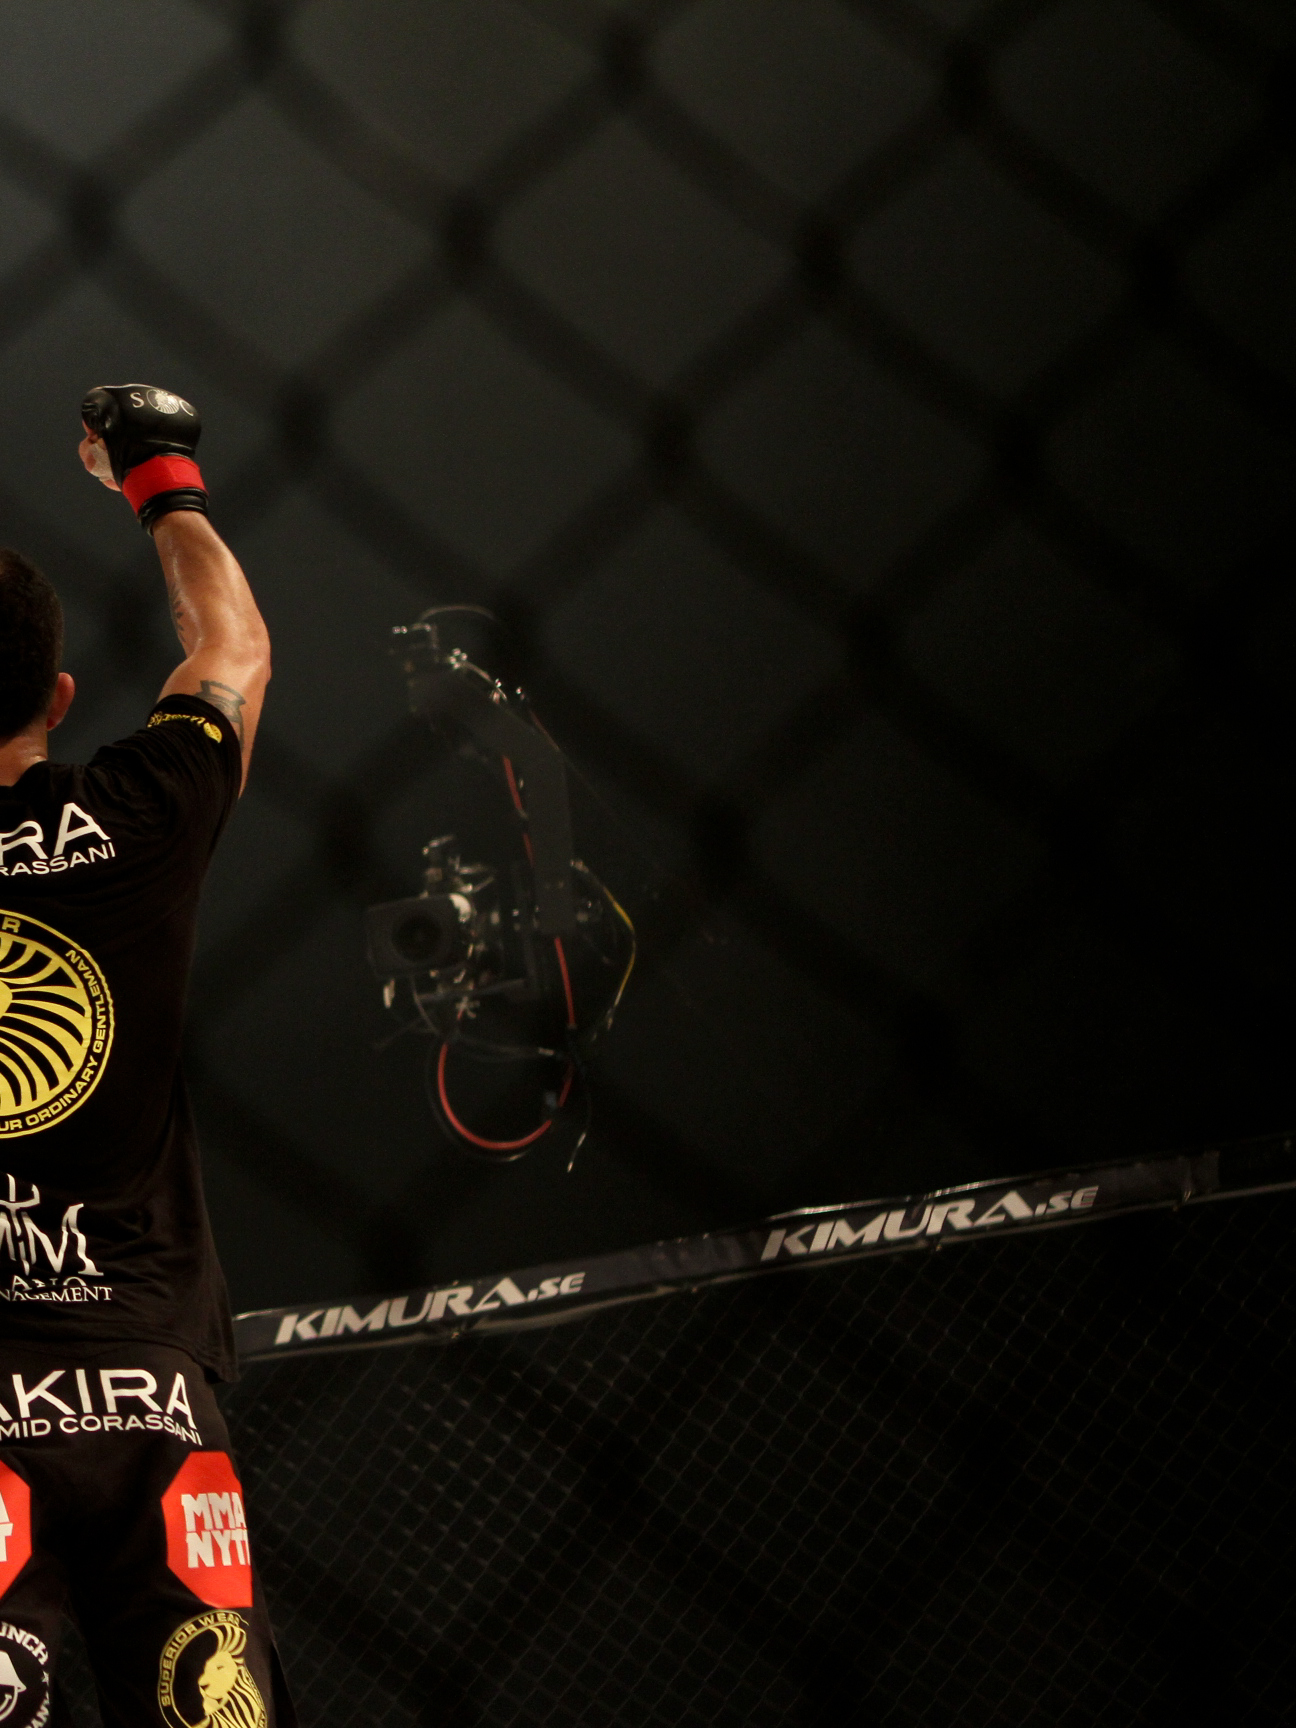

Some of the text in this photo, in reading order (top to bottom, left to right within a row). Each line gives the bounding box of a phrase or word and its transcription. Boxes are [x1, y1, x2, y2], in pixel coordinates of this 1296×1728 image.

[26, 1056, 99, 1127] ORDINARY
[65, 949, 108, 1054] GENTLEMAN
[59, 1414, 202, 1446] CORASSANI
[181, 1491, 247, 1532] MMA
[159, 1623, 198, 1707] SUPERIOR
